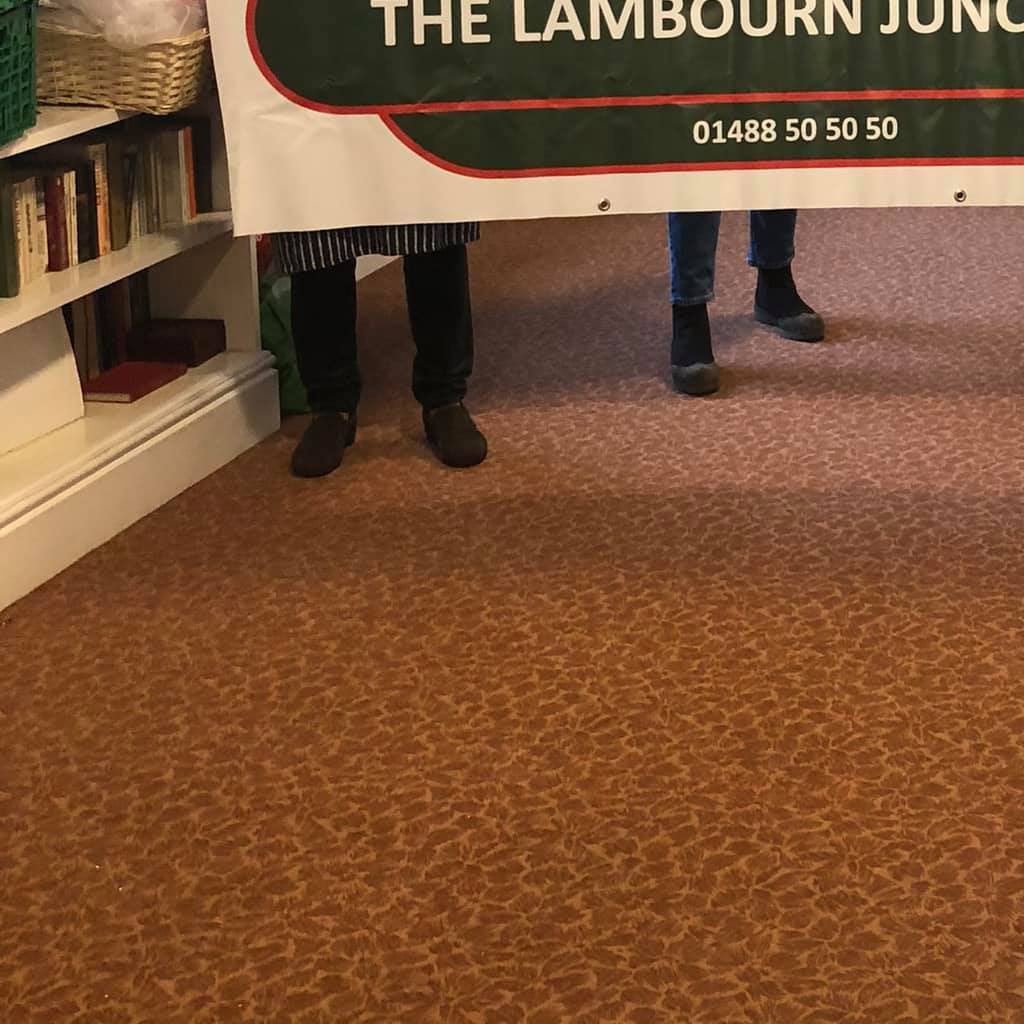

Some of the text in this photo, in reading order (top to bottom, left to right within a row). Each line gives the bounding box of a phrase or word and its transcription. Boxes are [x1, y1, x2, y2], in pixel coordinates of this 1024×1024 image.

[692, 115, 898, 144] 01488 50 50 50
